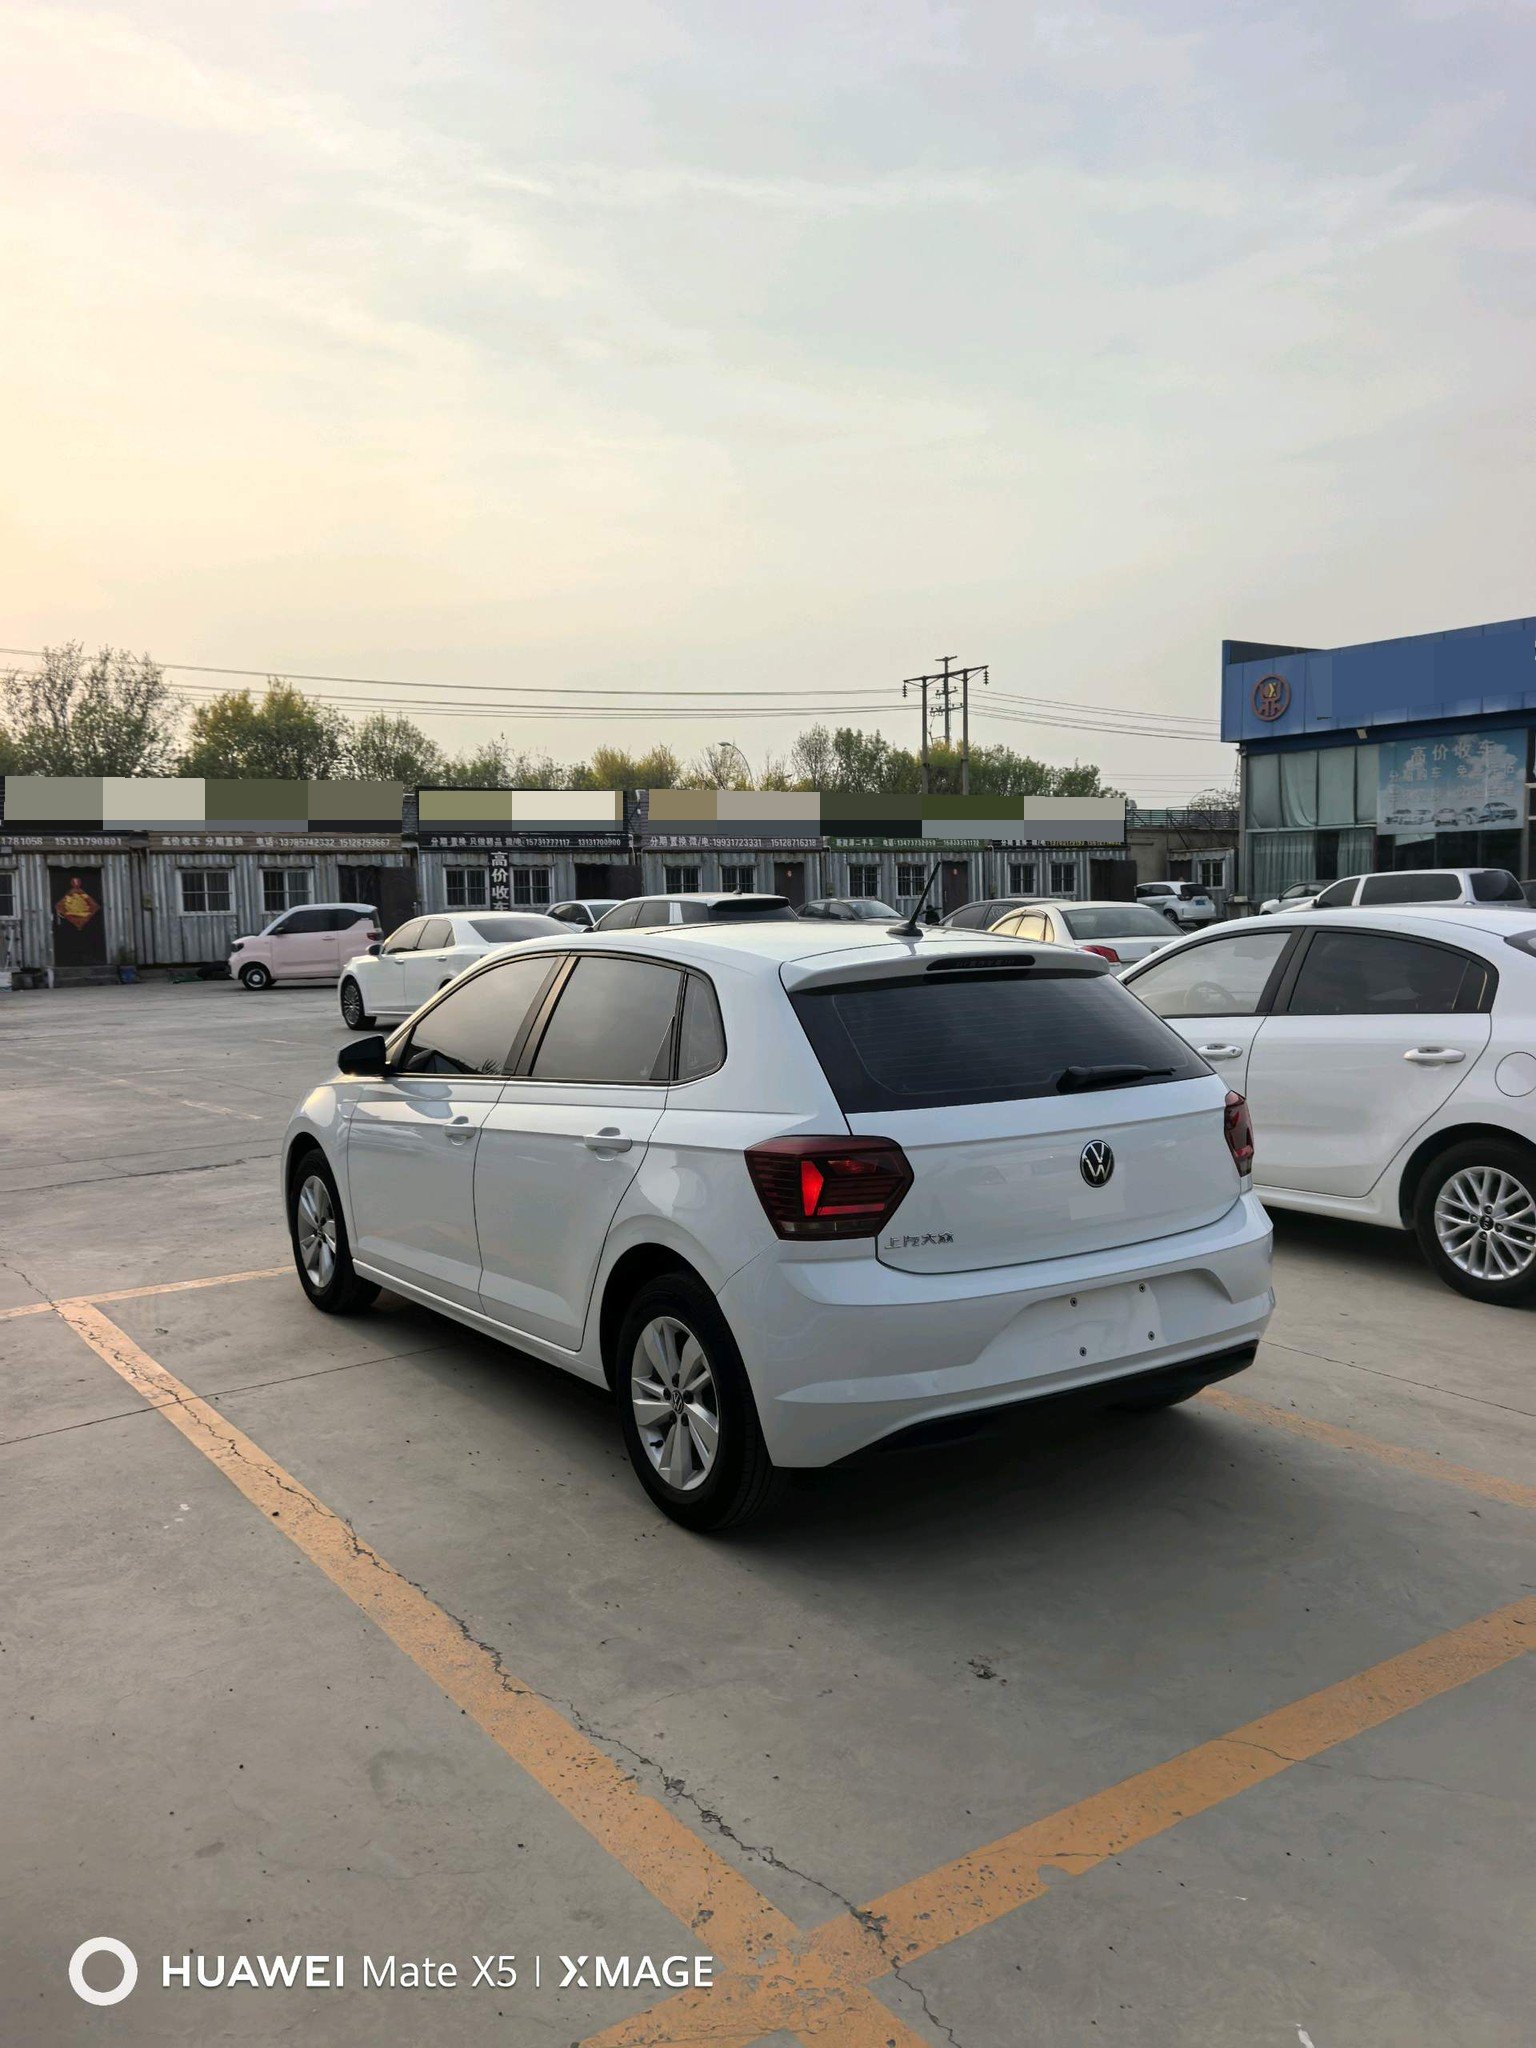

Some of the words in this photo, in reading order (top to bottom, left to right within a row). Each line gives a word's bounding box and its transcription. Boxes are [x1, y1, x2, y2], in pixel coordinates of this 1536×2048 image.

[650, 836, 667, 847] 分期
[490, 851, 510, 911] 高价收车
